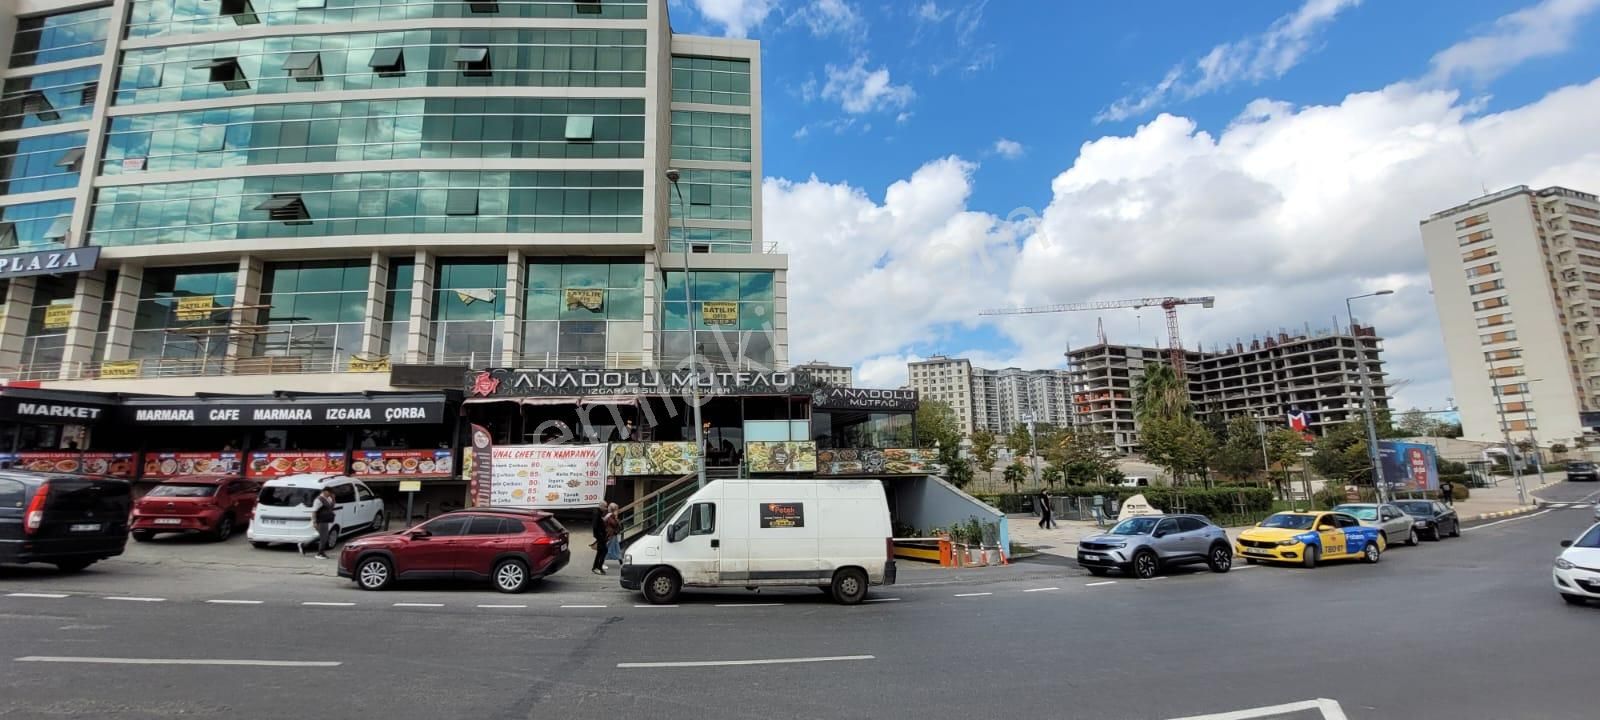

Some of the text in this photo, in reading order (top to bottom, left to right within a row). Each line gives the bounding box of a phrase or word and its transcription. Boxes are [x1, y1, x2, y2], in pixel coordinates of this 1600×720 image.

[0, 252, 79, 273] PLAZA
[514, 372, 660, 388] ANADOLU
[831, 388, 914, 400] ANADOLU
[17, 402, 101, 419] MARKET
[136, 407, 426, 422] MARMARA CAFE MARMARA IZGARA ÇORBA
